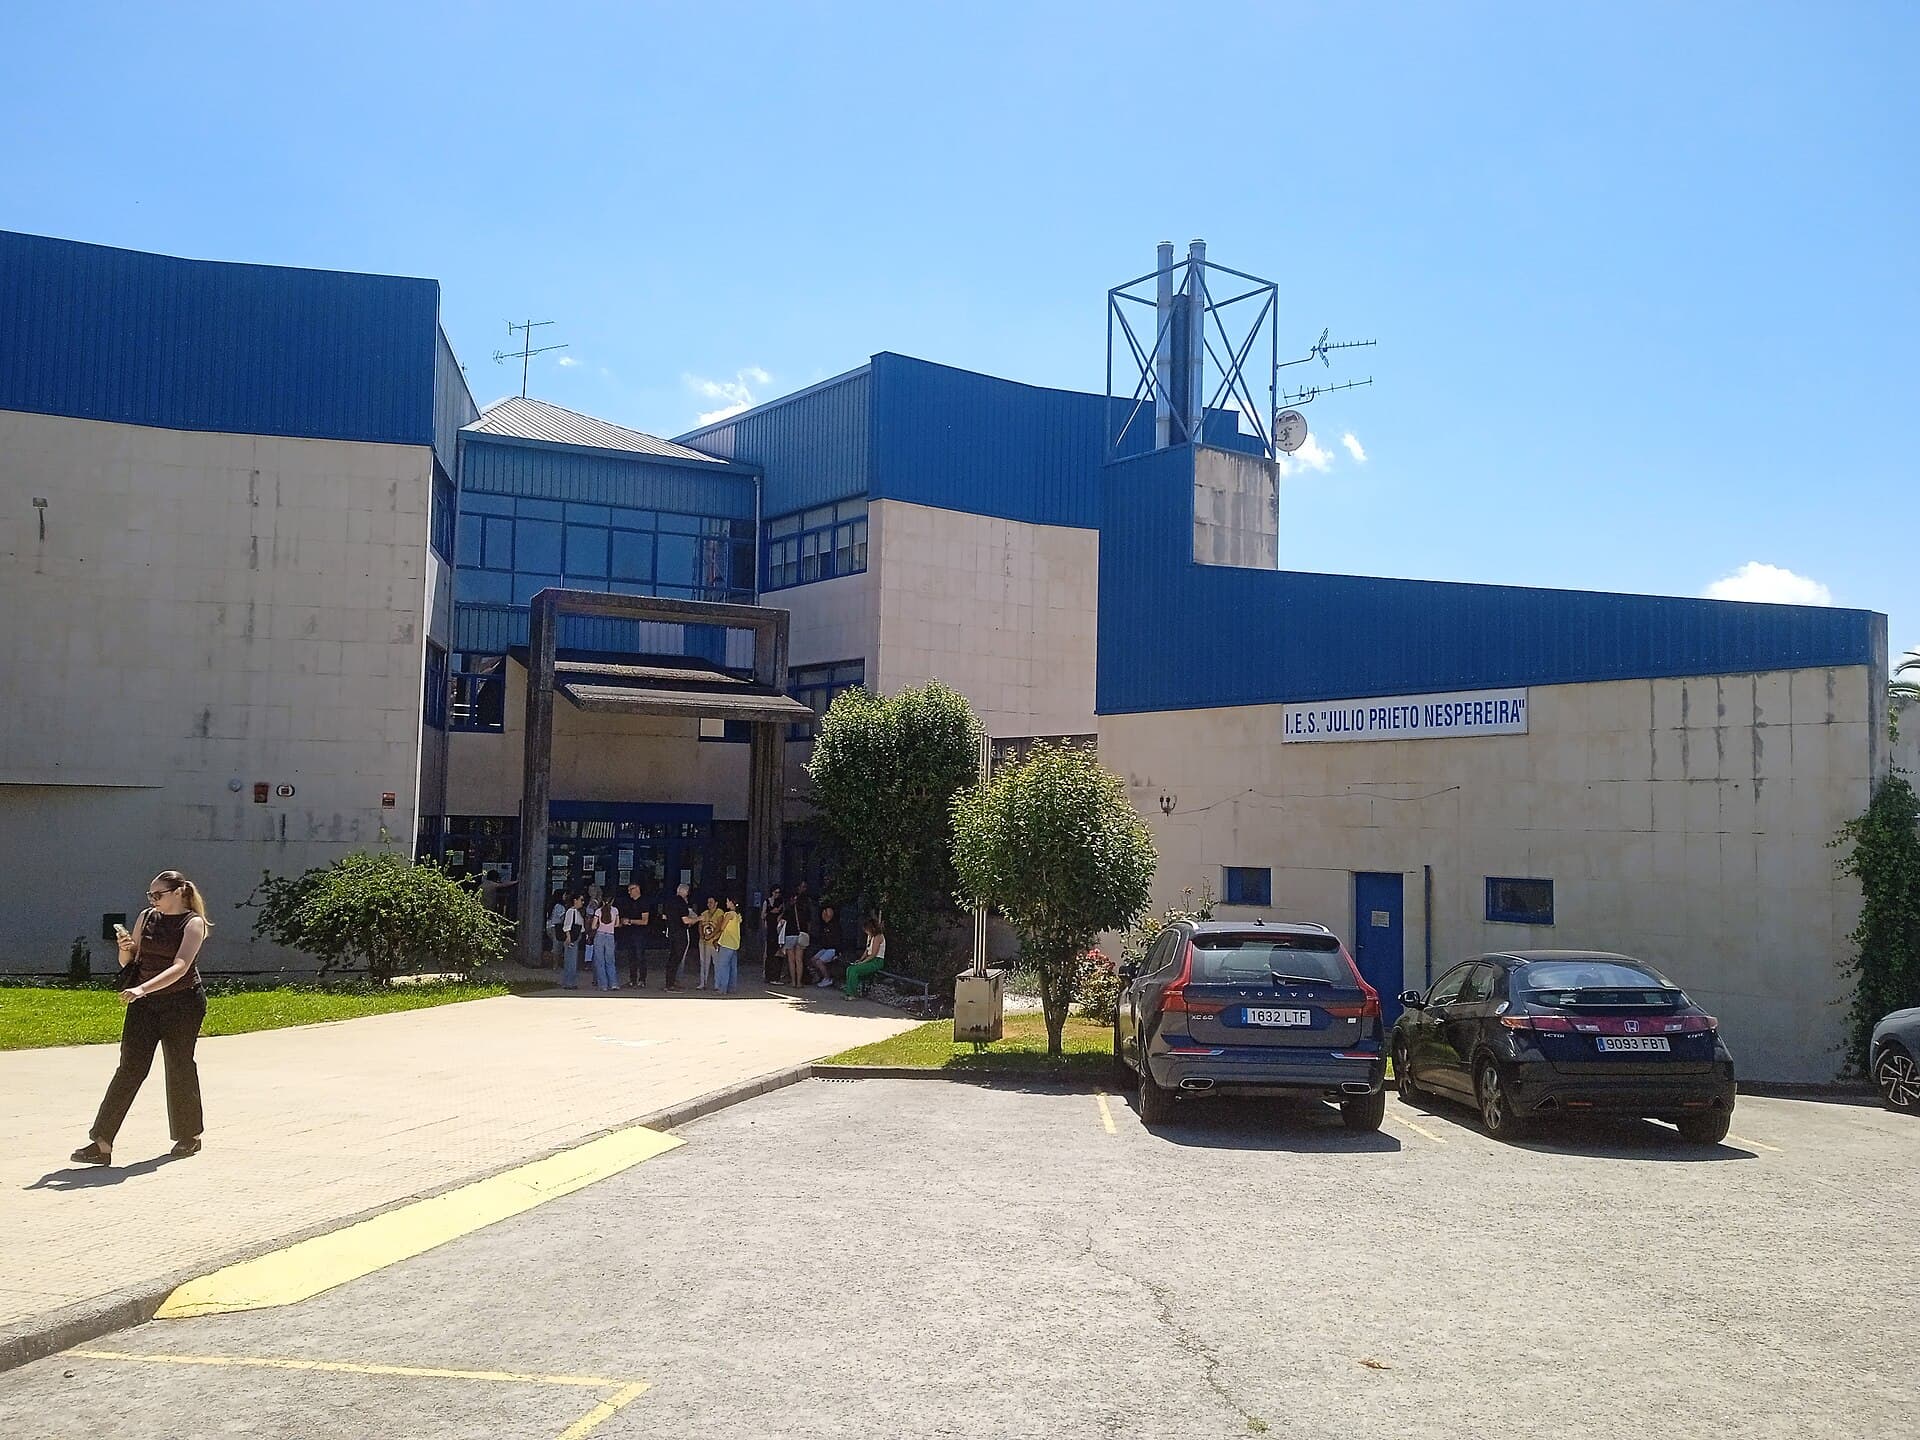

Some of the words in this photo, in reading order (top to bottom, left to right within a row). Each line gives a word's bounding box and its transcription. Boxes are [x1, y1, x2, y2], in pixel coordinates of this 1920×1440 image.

[1285, 711, 1320, 734] I.E.S.
[1321, 709, 1364, 733] "JULIO
[1369, 705, 1419, 730] PRIETO
[1424, 698, 1525, 727] NESPEREIRA"
[1251, 1010, 1281, 1023] 1632
[1284, 1011, 1307, 1024] LTF
[1606, 1039, 1639, 1050] 9093
[1642, 1038, 1666, 1050] FBT
